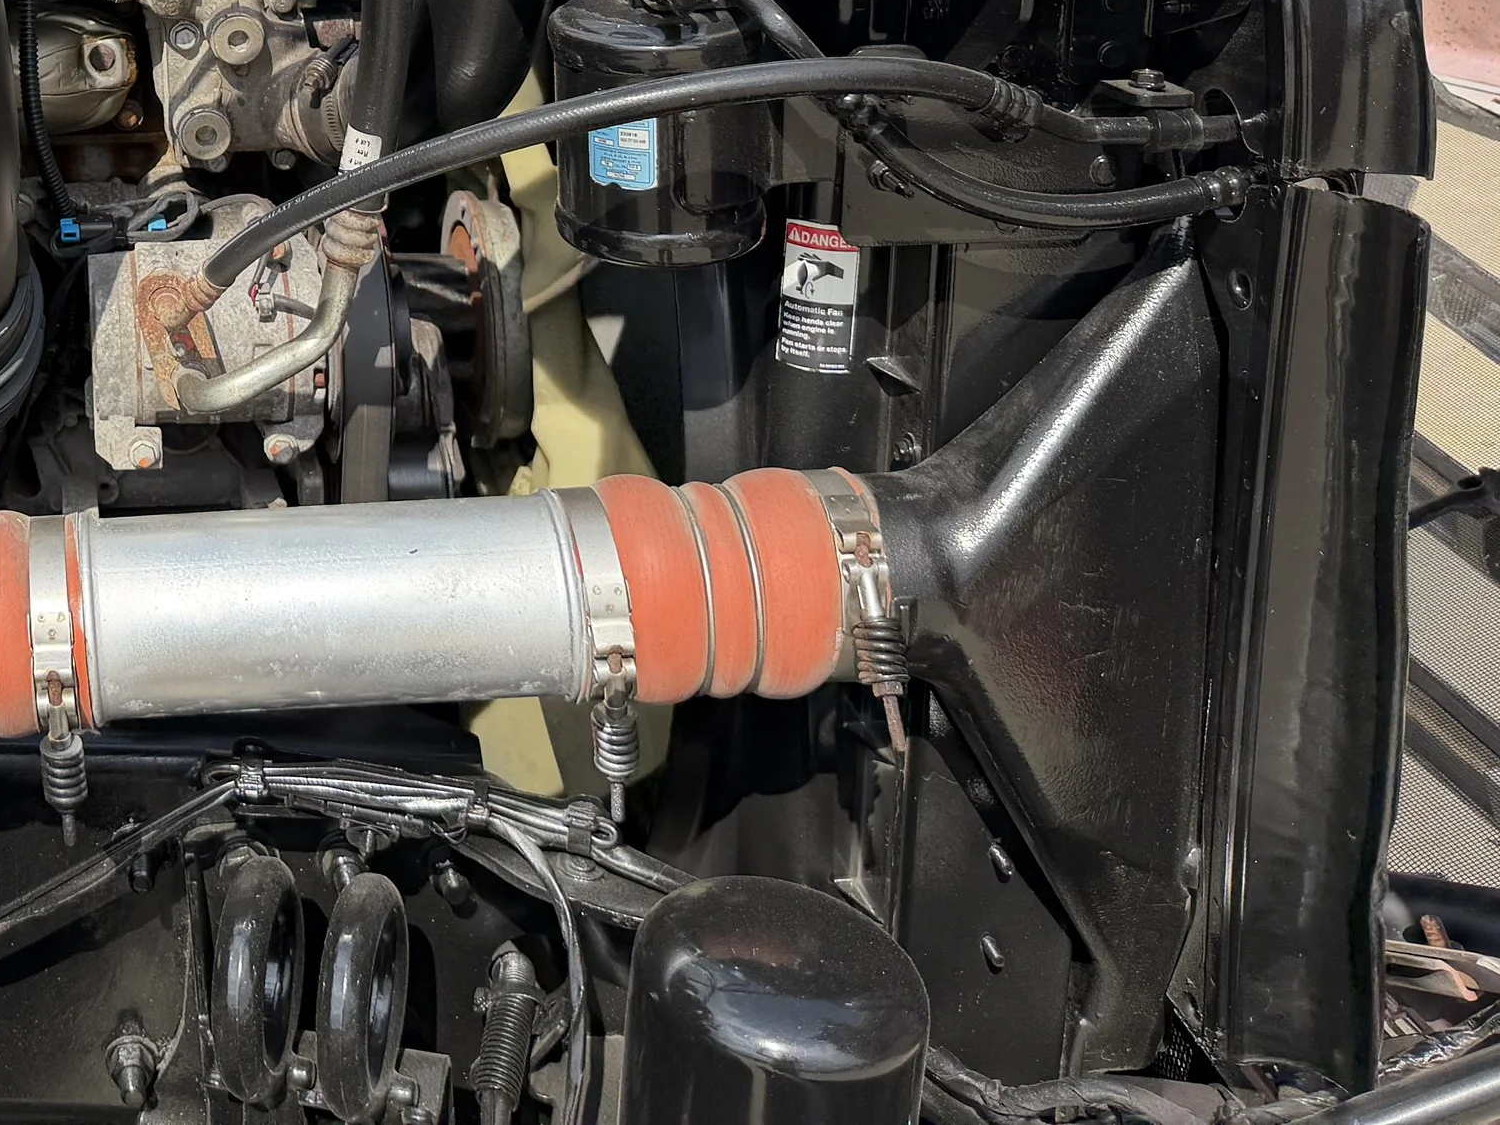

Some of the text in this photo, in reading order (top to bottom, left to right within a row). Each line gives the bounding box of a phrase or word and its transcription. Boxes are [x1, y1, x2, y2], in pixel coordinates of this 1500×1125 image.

[801, 231, 856, 249] DANGE
[784, 300, 844, 317] Automatic Fan
[783, 311, 800, 322] Keep
[801, 316, 824, 326] hands
[782, 320, 800, 328] when
[801, 324, 826, 334] engine
[781, 336, 794, 346] Fan
[794, 341, 816, 351] starts
[826, 346, 847, 354] stops
[781, 344, 790, 354] by
